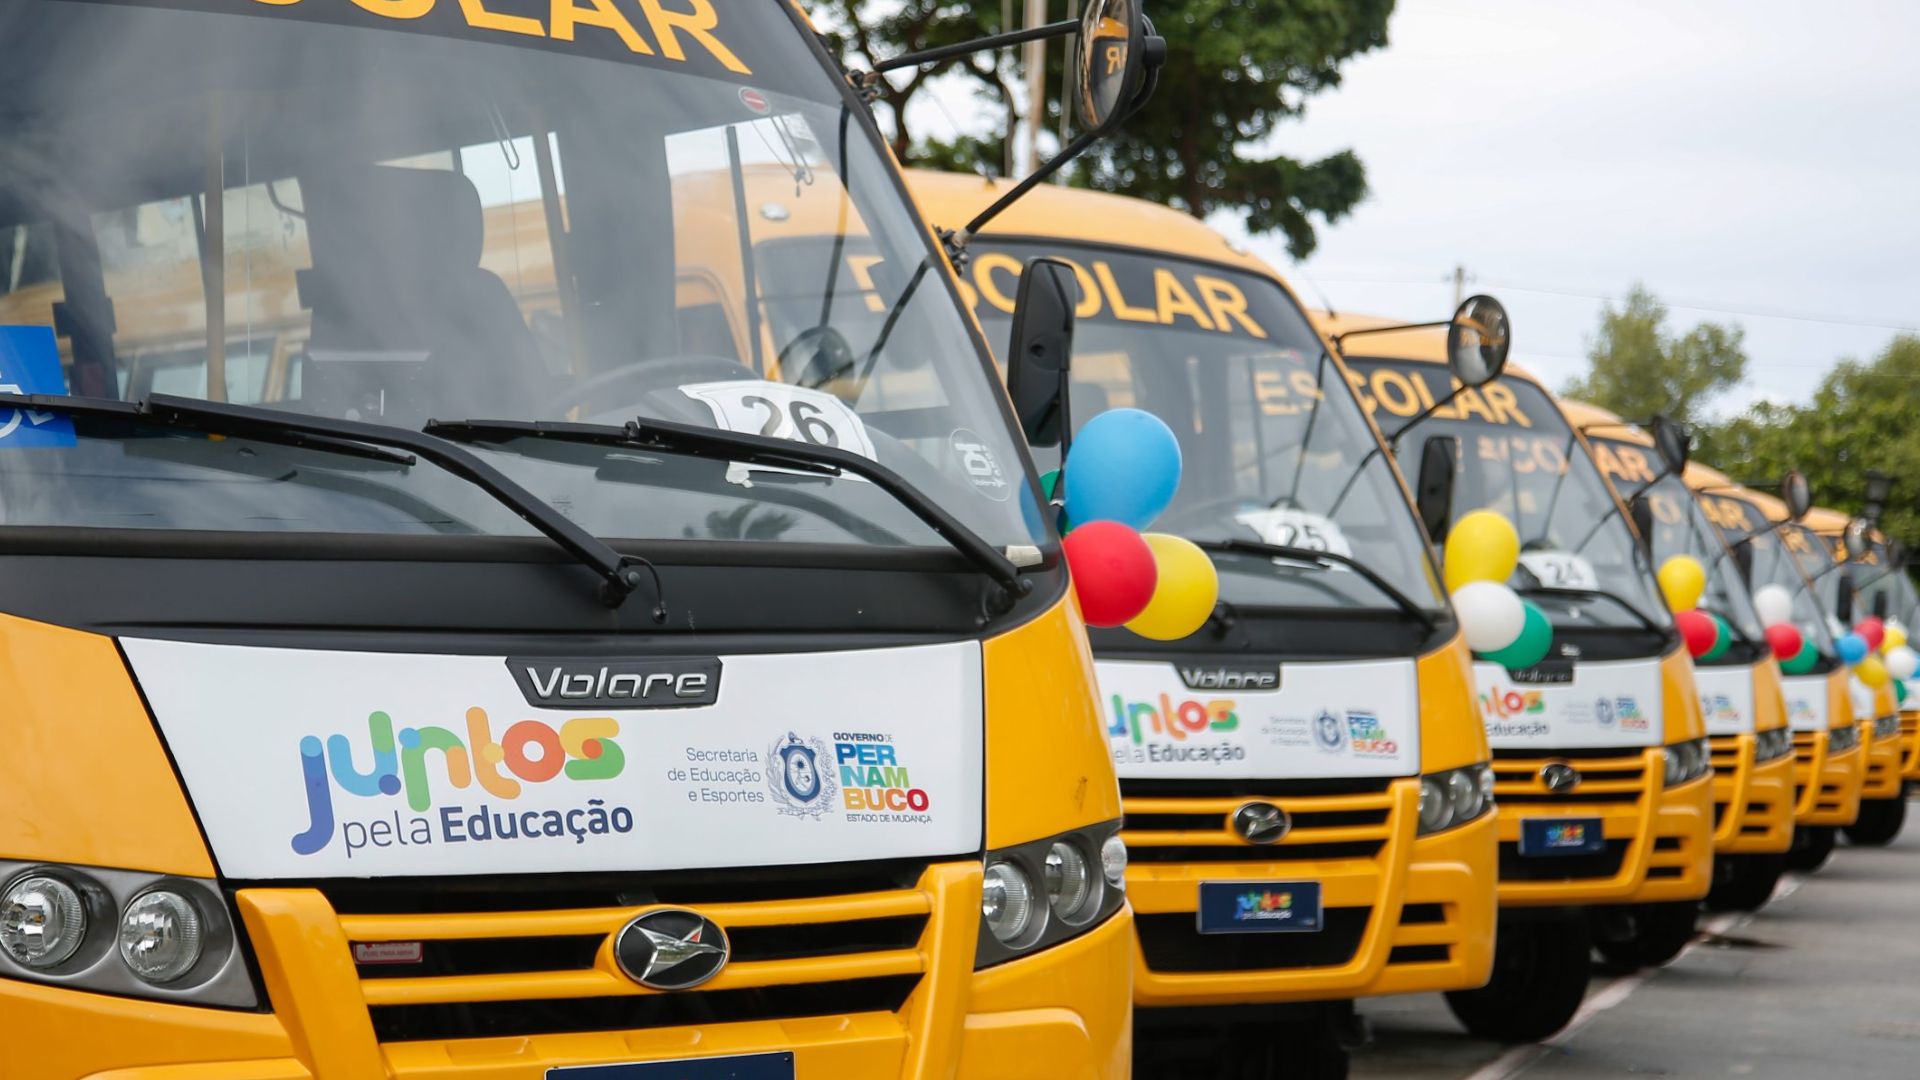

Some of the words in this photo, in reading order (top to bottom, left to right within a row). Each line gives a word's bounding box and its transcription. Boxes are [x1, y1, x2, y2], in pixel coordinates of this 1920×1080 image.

[741, 395, 839, 448] 26
[1277, 523, 1328, 552] 25
[526, 666, 707, 698] Volare
[1181, 666, 1275, 689] Volare
[1108, 692, 1239, 746] untos
[833, 732, 884, 742] GOVERNO
[686, 747, 758, 762] Secretaria
[835, 743, 897, 766] PER
[1113, 745, 1145, 764] ela
[1148, 742, 1246, 766] Educação
[668, 768, 686, 781] de
[690, 767, 761, 785] Educação
[839, 766, 910, 788] NAM
[688, 791, 697, 801] e
[701, 788, 764, 805] Esportes
[842, 788, 930, 812] BUCO
[342, 810, 432, 858] pela
[440, 799, 634, 844] Educação
[847, 813, 878, 822] ESTADO
[880, 814, 890, 822] DE
[892, 814, 932, 824] MUDANÇA
